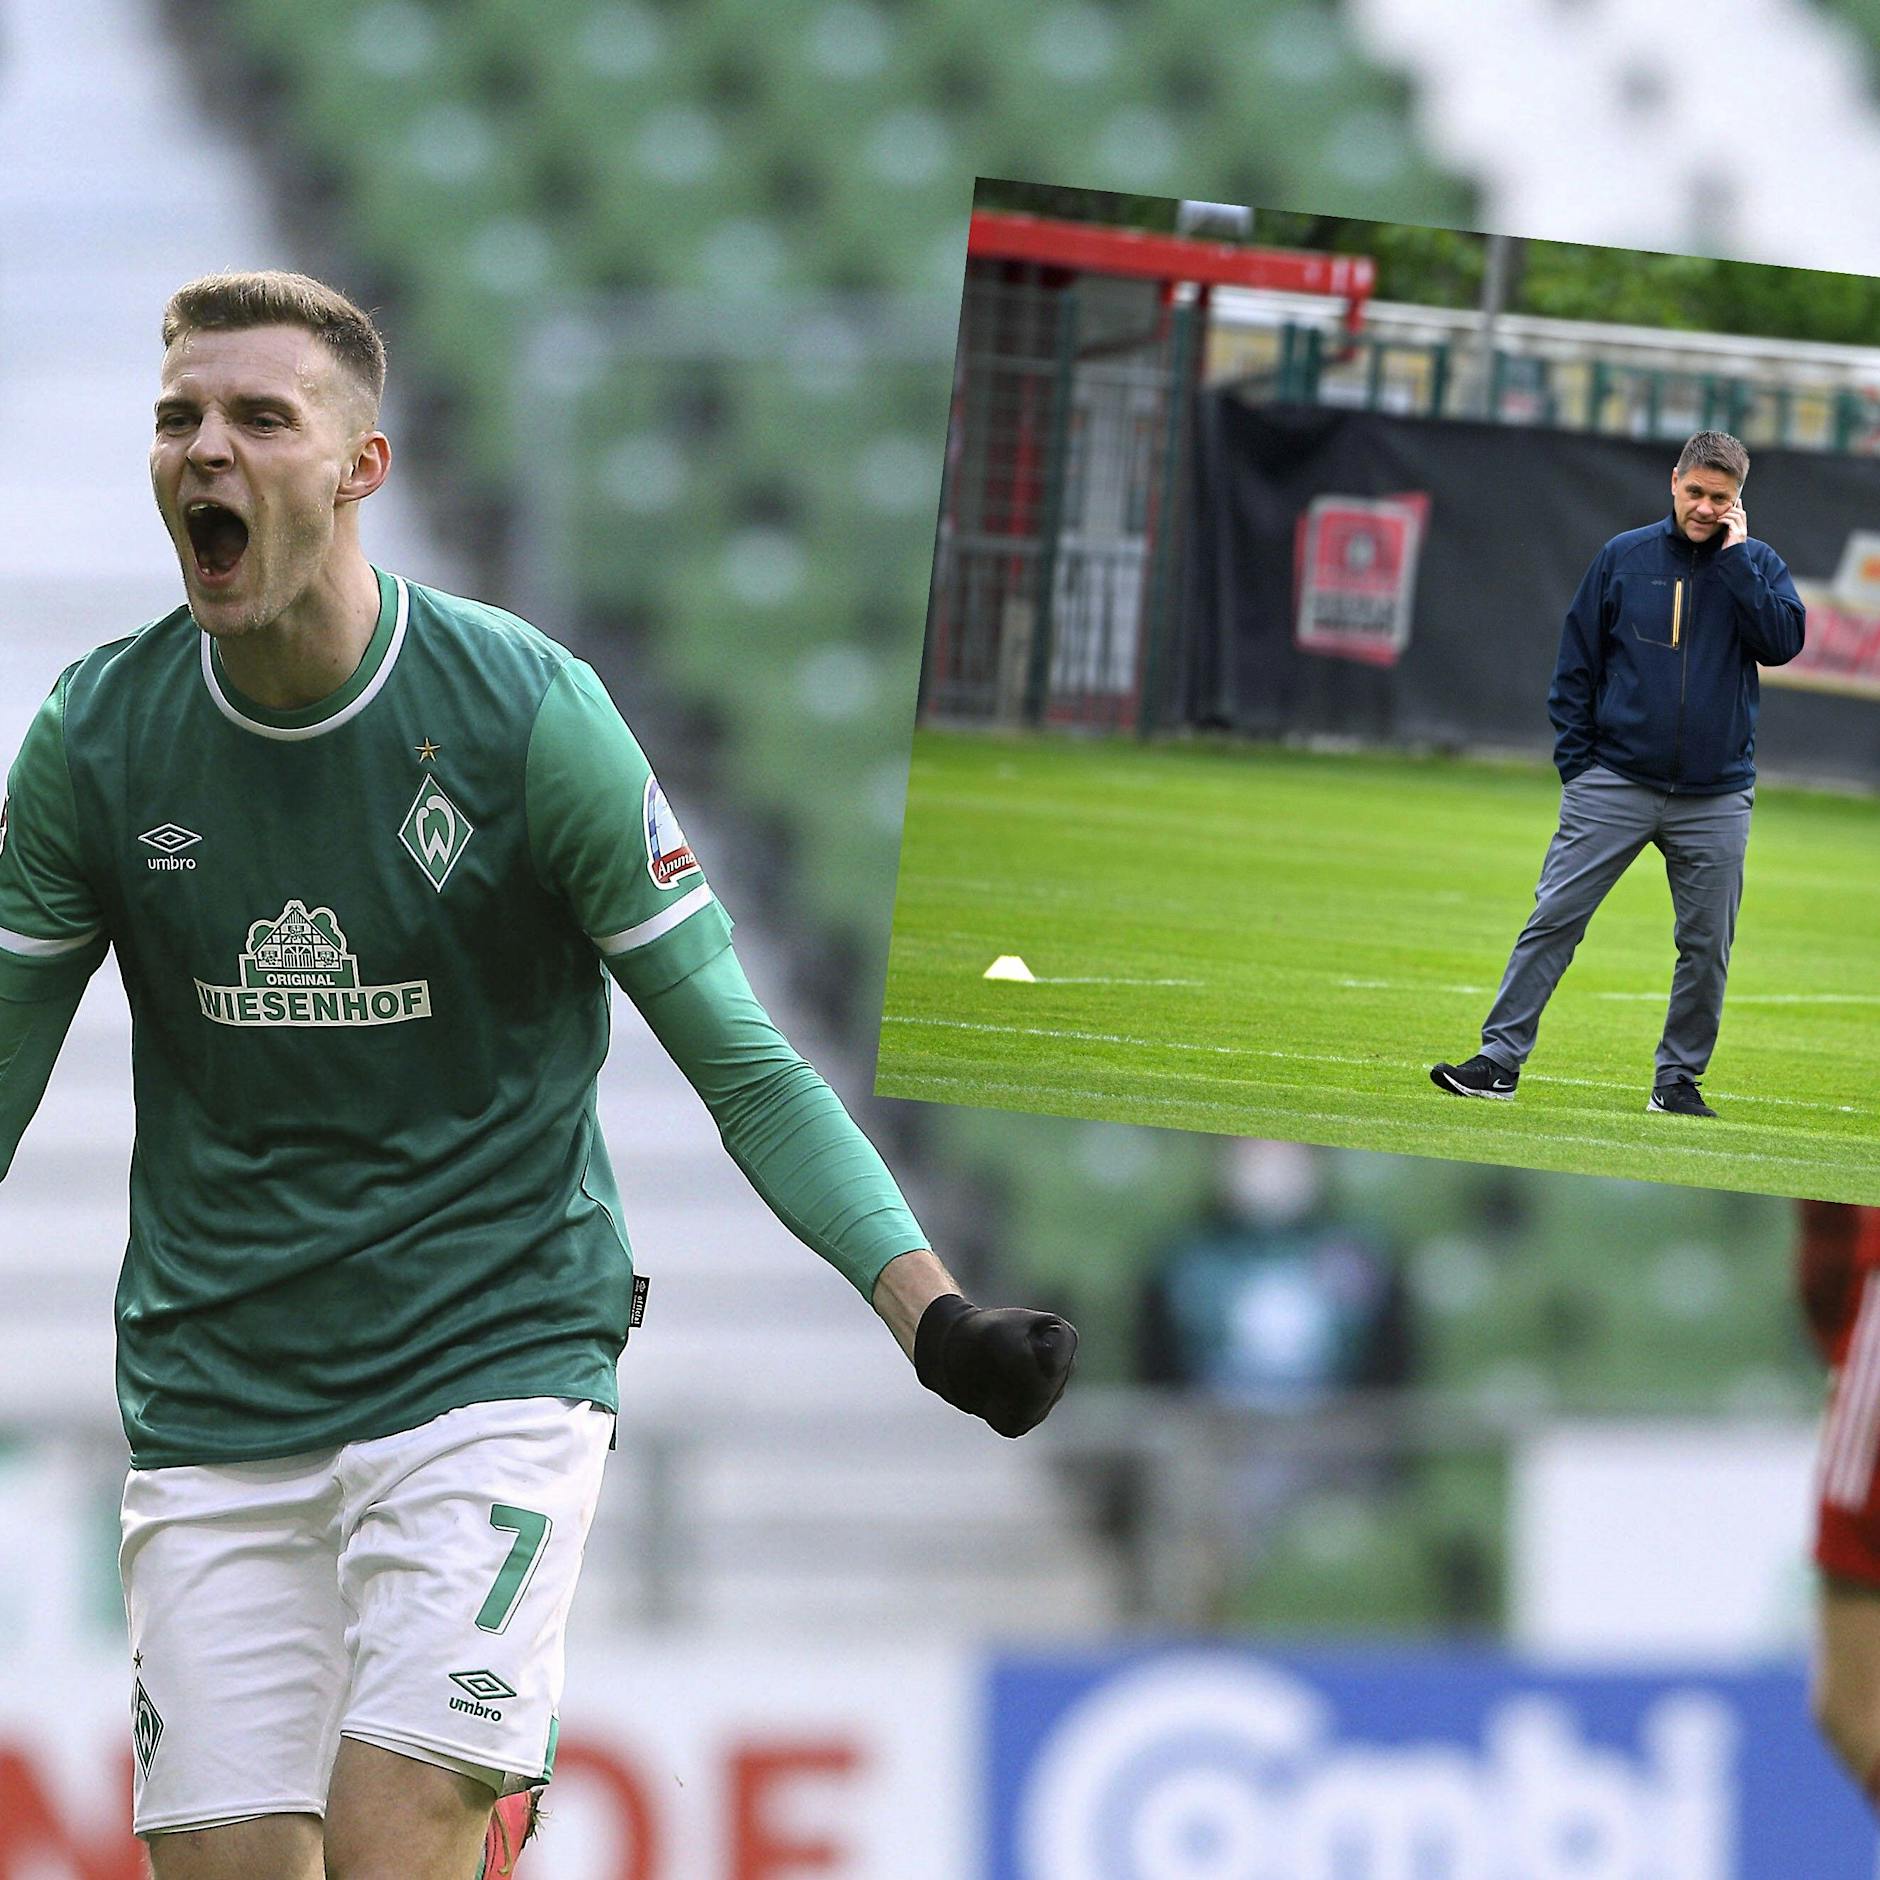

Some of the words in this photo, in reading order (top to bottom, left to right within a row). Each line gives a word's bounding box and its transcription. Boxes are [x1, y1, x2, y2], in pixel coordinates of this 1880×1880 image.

[147, 854, 197, 871] umbro
[266, 973, 336, 986] ORIGINAL
[201, 986, 423, 1021] WIESENHOF
[474, 1503, 553, 1635] 7
[448, 1696, 503, 1723] umbro
